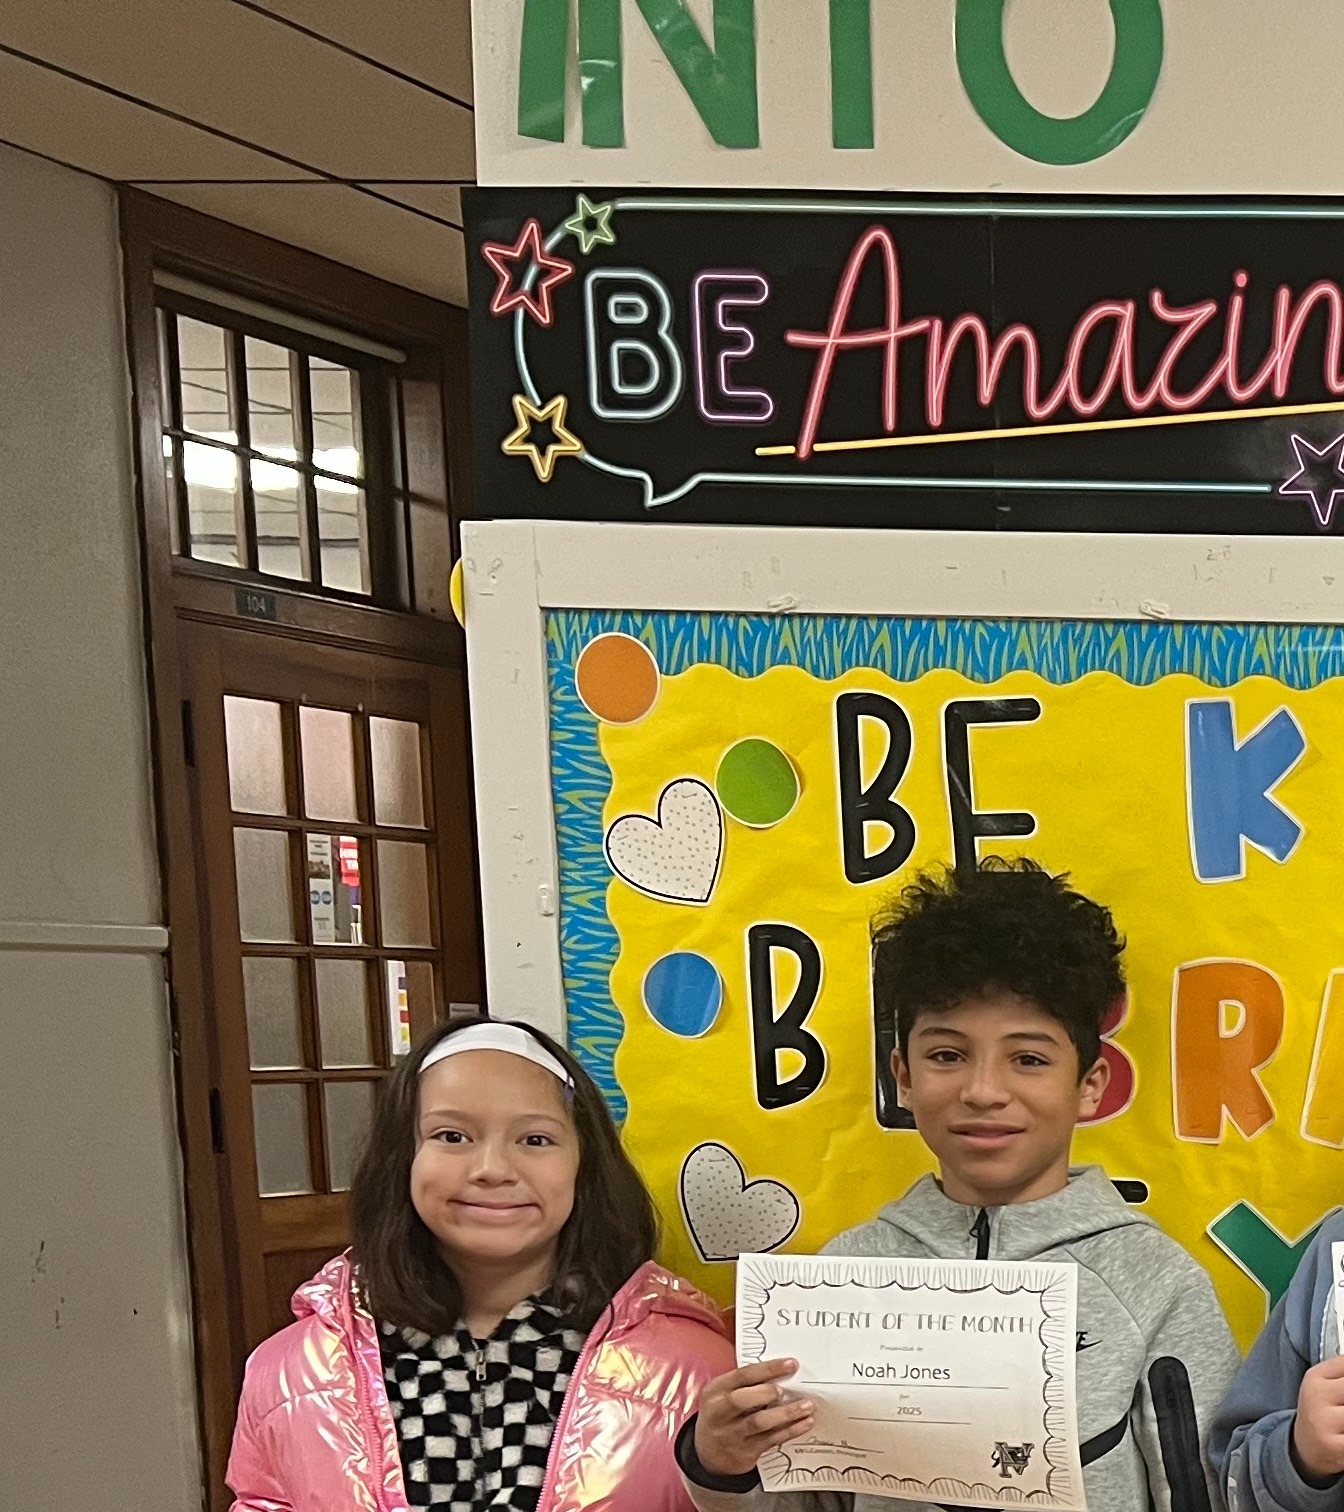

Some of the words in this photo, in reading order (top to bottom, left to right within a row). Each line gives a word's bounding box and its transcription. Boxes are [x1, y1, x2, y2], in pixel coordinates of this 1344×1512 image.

[584, 268, 774, 423] BE
[777, 1308, 873, 1329] STUDENT
[882, 1313, 909, 1330] OF
[914, 1313, 955, 1333] THE
[961, 1315, 1034, 1334] MONTH
[852, 1362, 896, 1380] Noah
[899, 1364, 951, 1380] Jones
[896, 1406, 923, 1416] 2025
